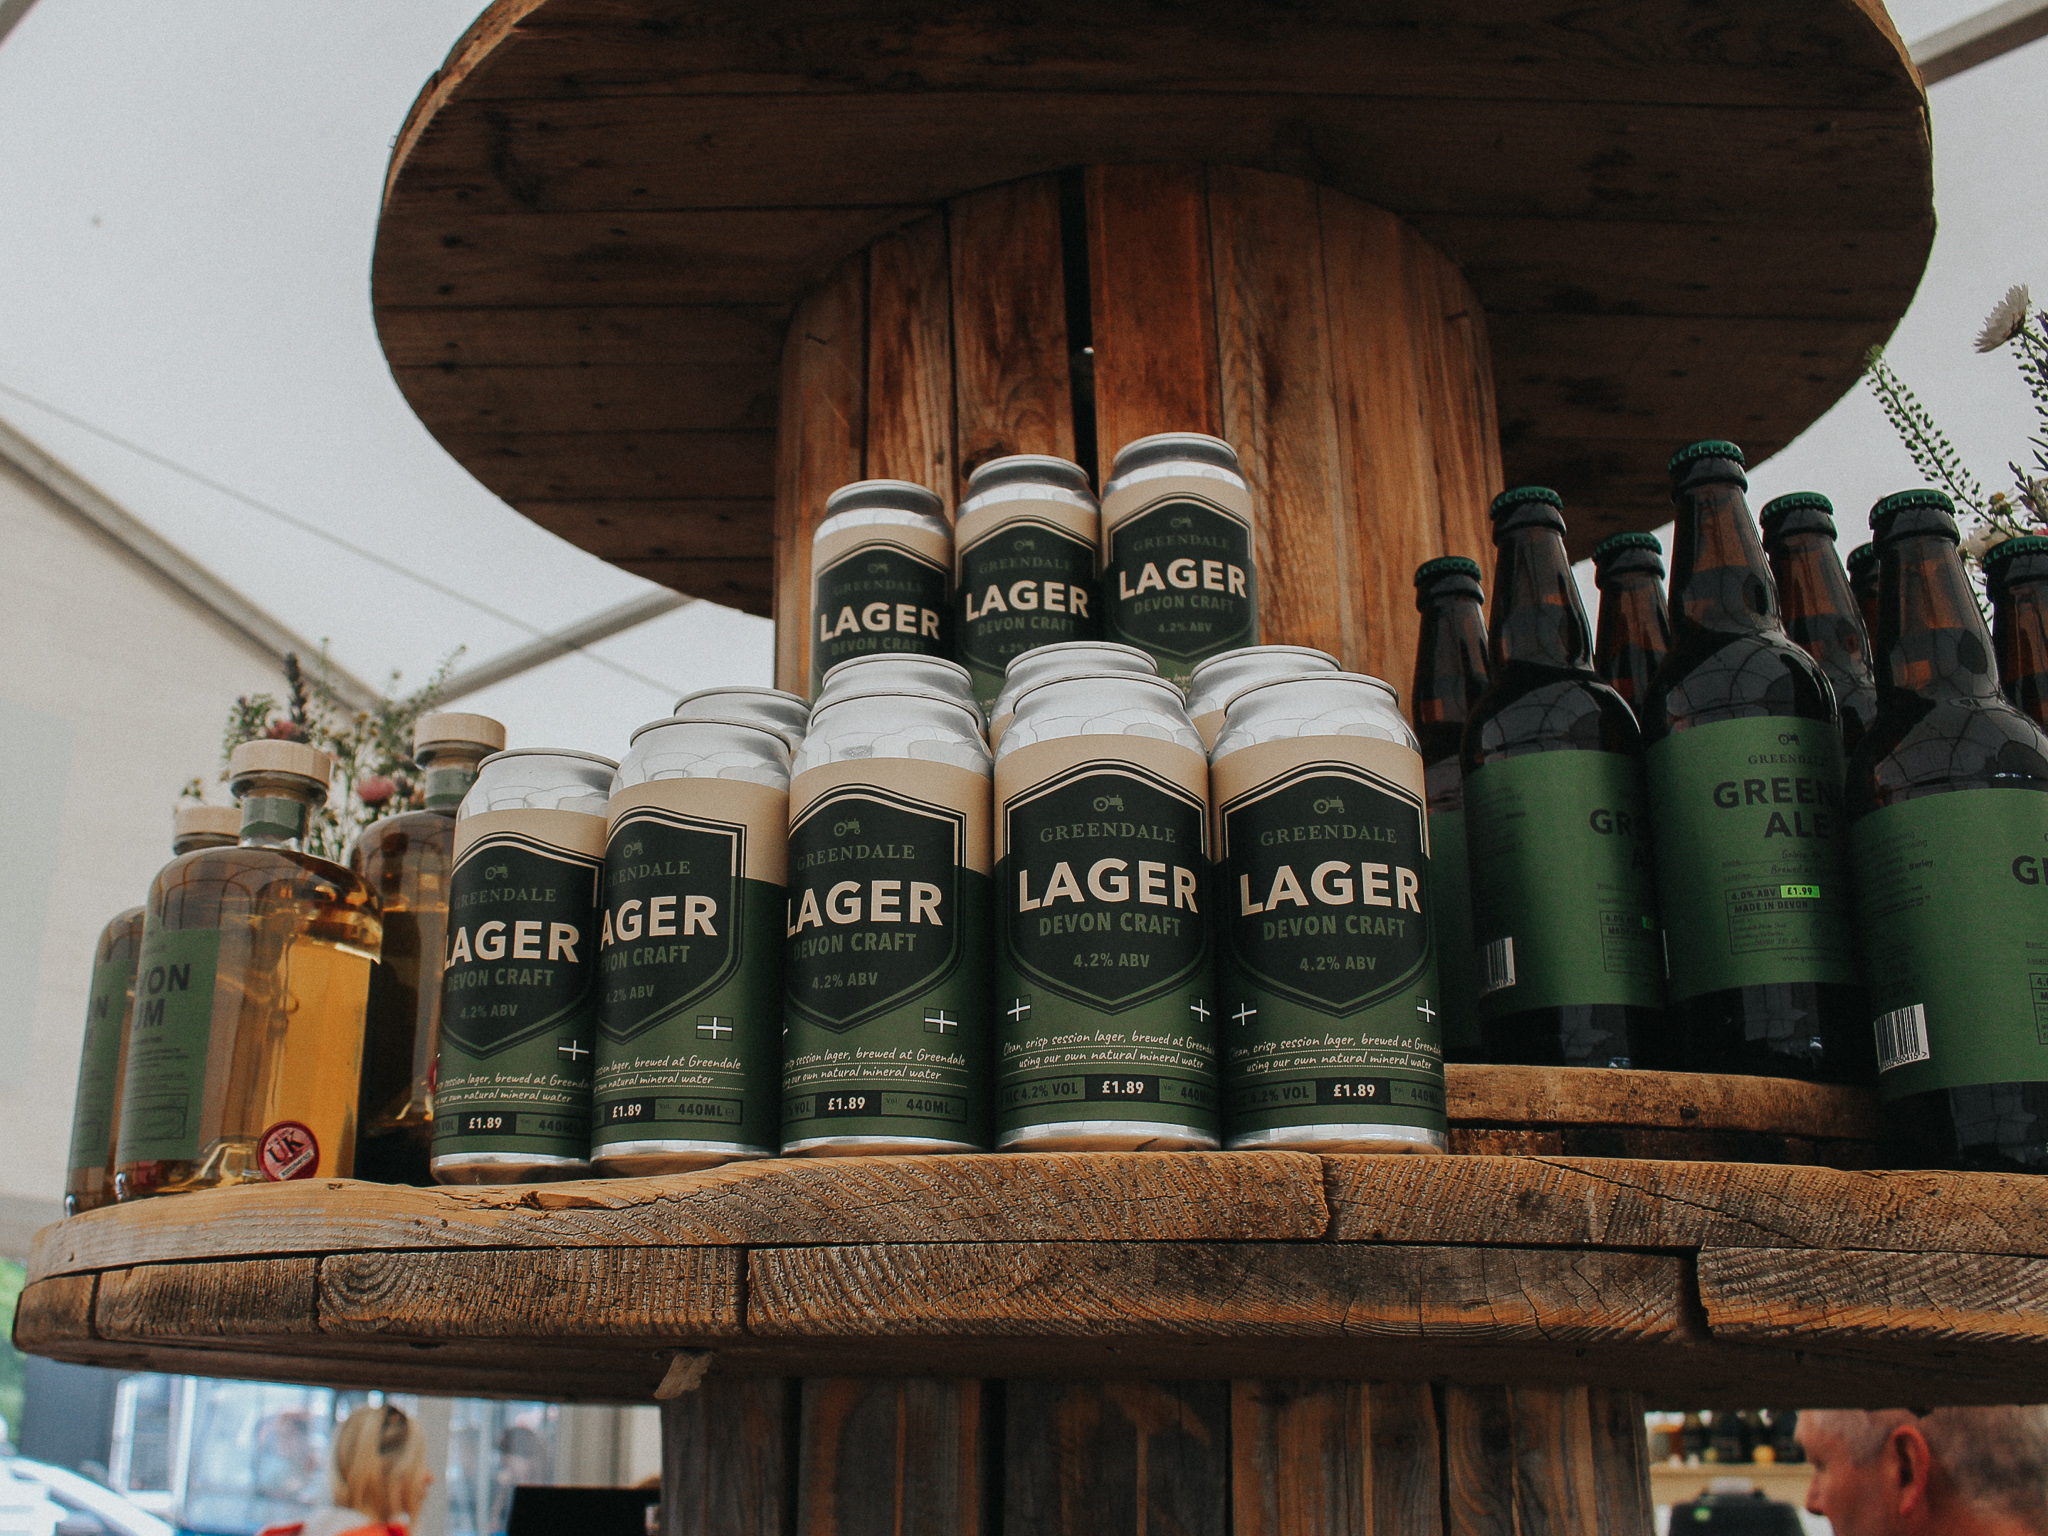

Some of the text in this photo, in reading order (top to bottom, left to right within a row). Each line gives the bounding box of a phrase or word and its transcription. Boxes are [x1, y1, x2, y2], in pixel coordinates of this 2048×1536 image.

[1119, 557, 1247, 601] LAGER
[965, 579, 1089, 623] LAGER
[1133, 595, 1234, 615] DEVON CRAFT
[820, 601, 940, 641] LAGER
[977, 616, 1074, 636] DEVON CRAFT
[1189, 622, 1213, 633] ABV
[831, 636, 878, 656] DEVON
[1713, 777, 1835, 809] GREEN
[1040, 822, 1176, 843] GREENDALE
[1260, 824, 1397, 846] GREENDALE
[1763, 811, 1830, 839] ALE
[797, 844, 915, 870] GREENDALE
[1019, 857, 1199, 914] LAGER
[1240, 860, 1422, 917] LAGER
[1787, 887, 1813, 896] £1.99
[787, 880, 943, 939] LAGER
[1734, 900, 1808, 913] MADE IN DEVON
[1039, 912, 1181, 937] DEVON CRAFT
[1263, 915, 1405, 940] DEVON CRAFT
[444, 920, 580, 971] LAGER
[632, 945, 691, 966] CRAFT
[794, 933, 917, 962] DEVON CRAFT
[1073, 953, 1150, 968] 4.2% ABV
[1300, 956, 1377, 971] 4.2% ABV
[495, 968, 554, 986] CRAFT
[812, 972, 878, 990] 4.2% ABV
[630, 984, 655, 999] ABV
[460, 1004, 518, 1019] 4.2% ABV
[1025, 1037, 1049, 1050] crisp
[1051, 1033, 1090, 1046] session
[1094, 1030, 1126, 1045] lager,
[1131, 1030, 1171, 1045] brewed
[1173, 1036, 1184, 1047] at
[1253, 1042, 1277, 1056] crisp
[1280, 1037, 1320, 1050] session
[1324, 1033, 1356, 1047] lager,
[1361, 1033, 1399, 1048] brewed
[1402, 1039, 1413, 1049] at
[611, 1060, 631, 1073] lager,
[634, 1055, 671, 1069] brewed
[672, 1057, 685, 1067] at
[688, 1054, 742, 1070] Greendale
[796, 1053, 822, 1066] session
[823, 1049, 851, 1064] lager,
[855, 1047, 897, 1060] brewed
[899, 1049, 912, 1060] at
[916, 1048, 966, 1067] Greendale
[1019, 1048, 1204, 1069] using our own natural mineral water
[1246, 1052, 1432, 1073] using our own natural mineral water
[467, 1073, 491, 1087] lager,
[495, 1072, 533, 1085] brewed
[534, 1074, 546, 1085] at
[608, 1074, 639, 1088] natural
[640, 1072, 680, 1085] mineral
[681, 1074, 714, 1085] water
[802, 1073, 818, 1081] own
[821, 1065, 861, 1078] natural
[863, 1065, 907, 1077] mineral
[909, 1067, 942, 1080] water
[463, 1089, 499, 1099] natural
[500, 1090, 539, 1101] mineral
[542, 1092, 572, 1103] water
[1021, 1084, 1049, 1098] 4.2%
[1052, 1082, 1078, 1096] VOL
[1102, 1080, 1144, 1094] £1.89
[1282, 1086, 1309, 1099] VOL
[1334, 1084, 1376, 1097] £1.89
[612, 1103, 642, 1118] £1.89
[677, 1103, 723, 1117] 440ML
[794, 1100, 811, 1113] VOL
[828, 1097, 866, 1111] £1.89
[906, 1098, 950, 1113] 440ML
[468, 1117, 502, 1129] £1.89
[266, 1136, 305, 1163] UK
